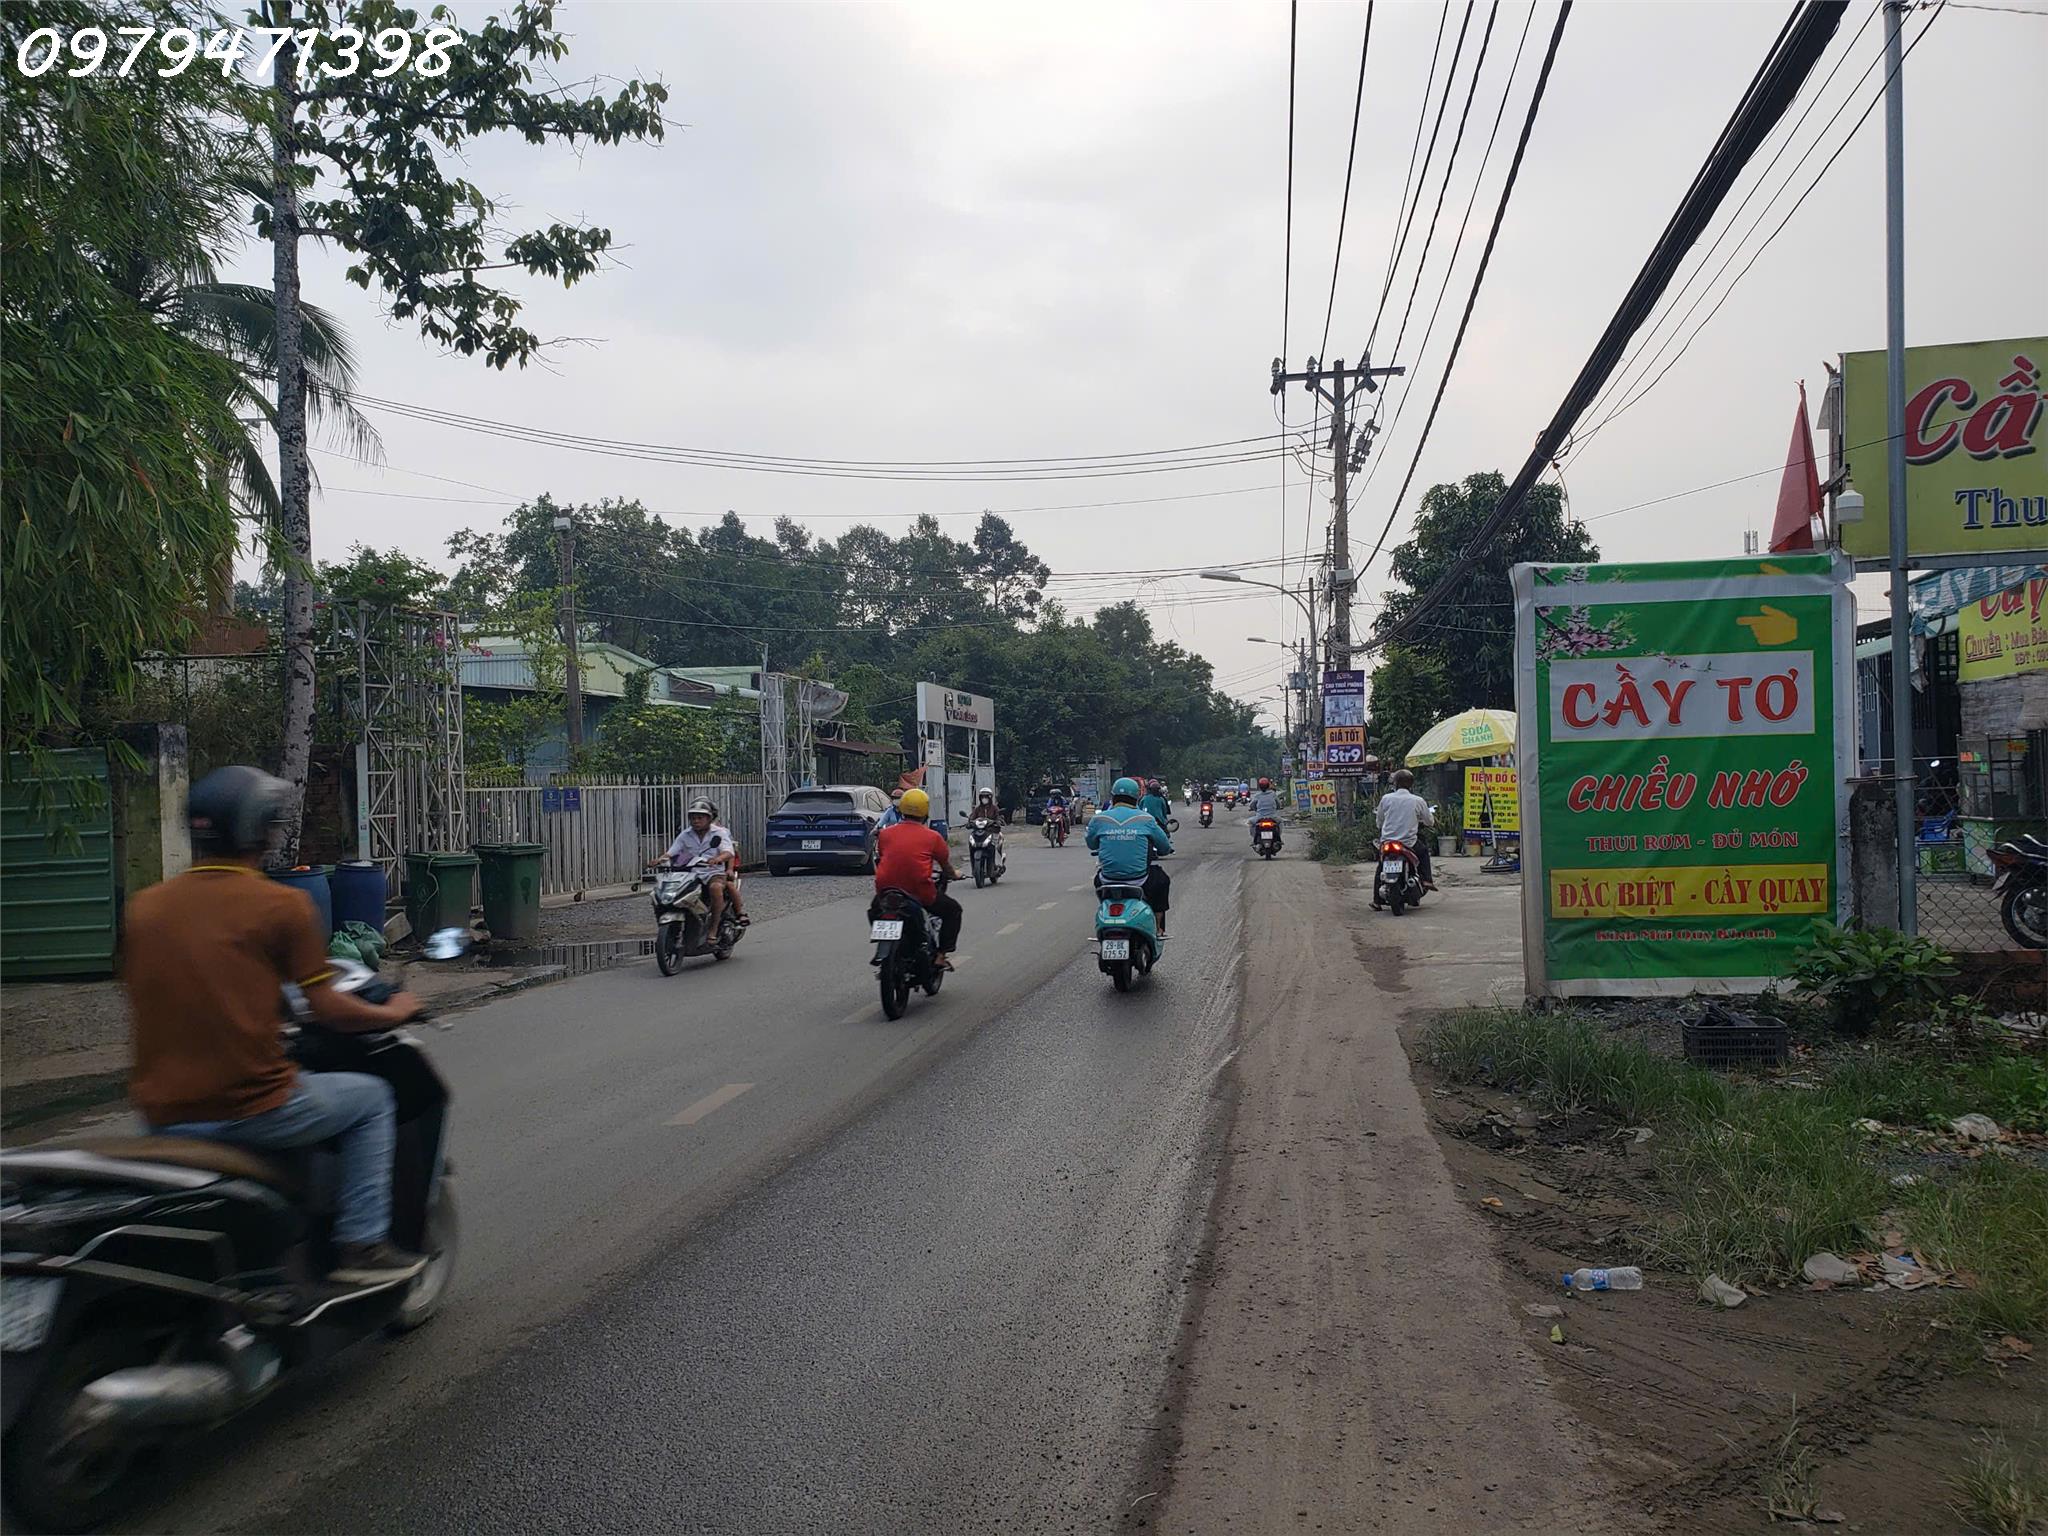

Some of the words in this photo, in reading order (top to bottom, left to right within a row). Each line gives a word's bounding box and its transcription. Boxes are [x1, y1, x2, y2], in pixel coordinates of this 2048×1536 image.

[1562, 663, 1697, 729] CẦY
[1716, 668, 1799, 724] TƠ
[1329, 730, 1343, 742] GIÁ
[1345, 728, 1359, 742] TỐT
[1329, 748, 1361, 763] 3tr9
[1567, 755, 1698, 813] CHIỀU
[1707, 760, 1808, 810] NHỚ
[1586, 836, 1638, 852] THUI
[1643, 834, 1692, 851] RƠM
[1712, 828, 1743, 851] ĐỦ
[1749, 828, 1799, 849] MÓN
[1559, 877, 1611, 916] ĐẶC
[1617, 876, 1676, 915] BIỆT
[1704, 868, 1753, 906] CẦY
[1758, 878, 1826, 912] QUAY
